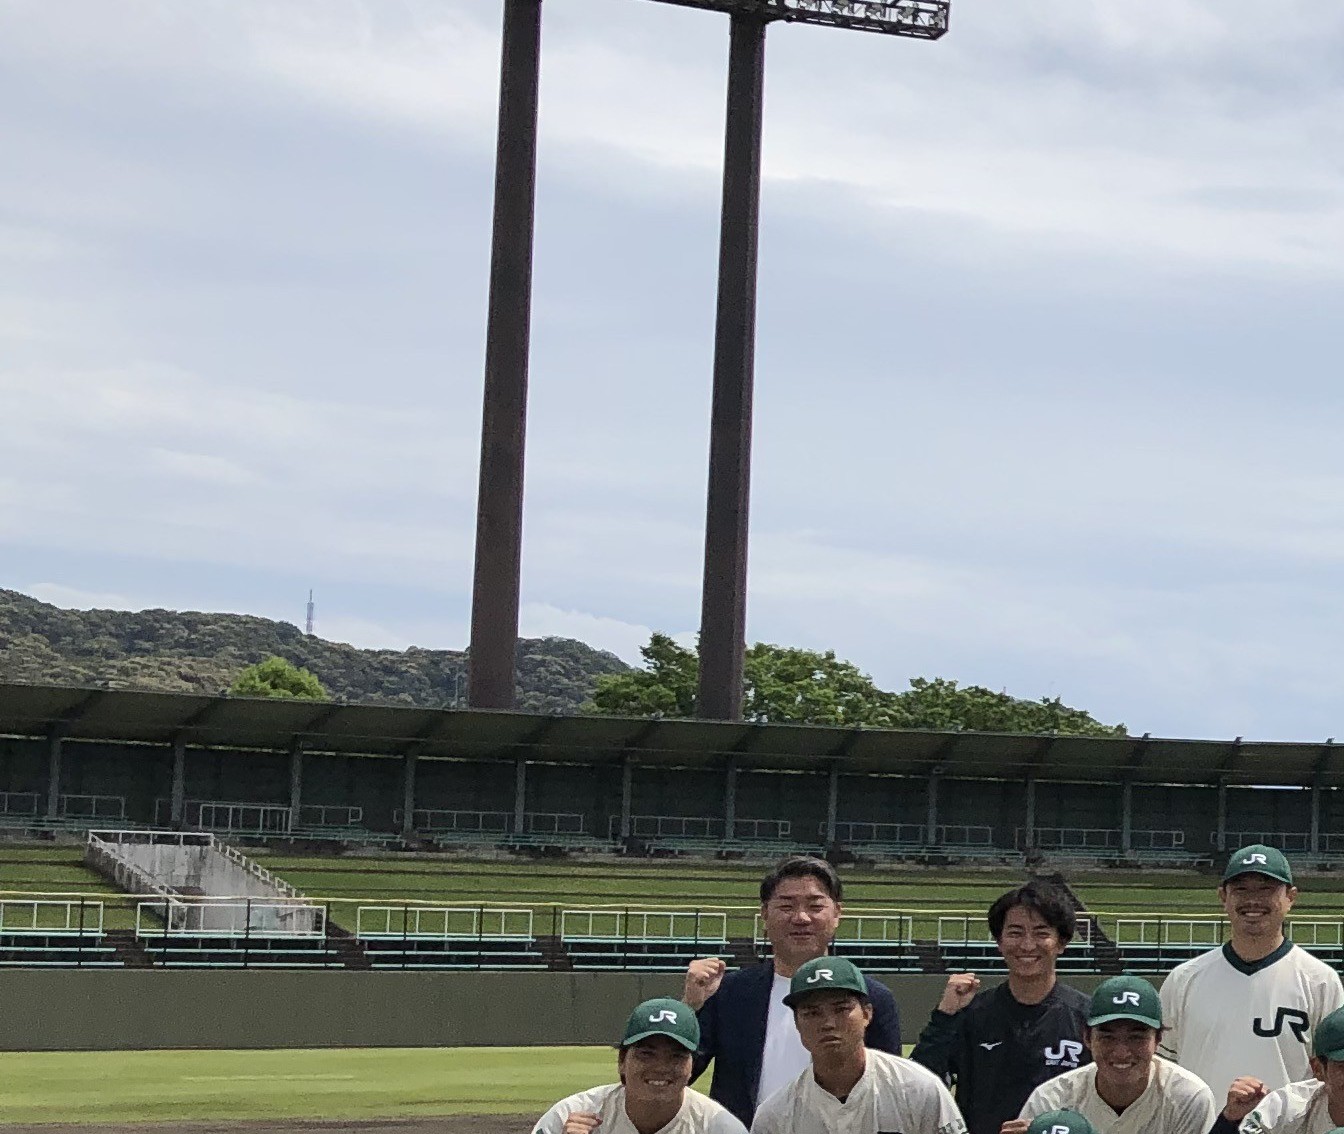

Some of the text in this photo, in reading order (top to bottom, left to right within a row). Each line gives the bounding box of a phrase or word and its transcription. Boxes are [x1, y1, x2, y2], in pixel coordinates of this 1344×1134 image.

[1242, 852, 1267, 865] JR
[806, 968, 834, 983] JR
[1112, 991, 1140, 1007] JR
[648, 1009, 678, 1025] JR
[1253, 1007, 1310, 1044] JR
[1044, 1039, 1083, 1062] JR
